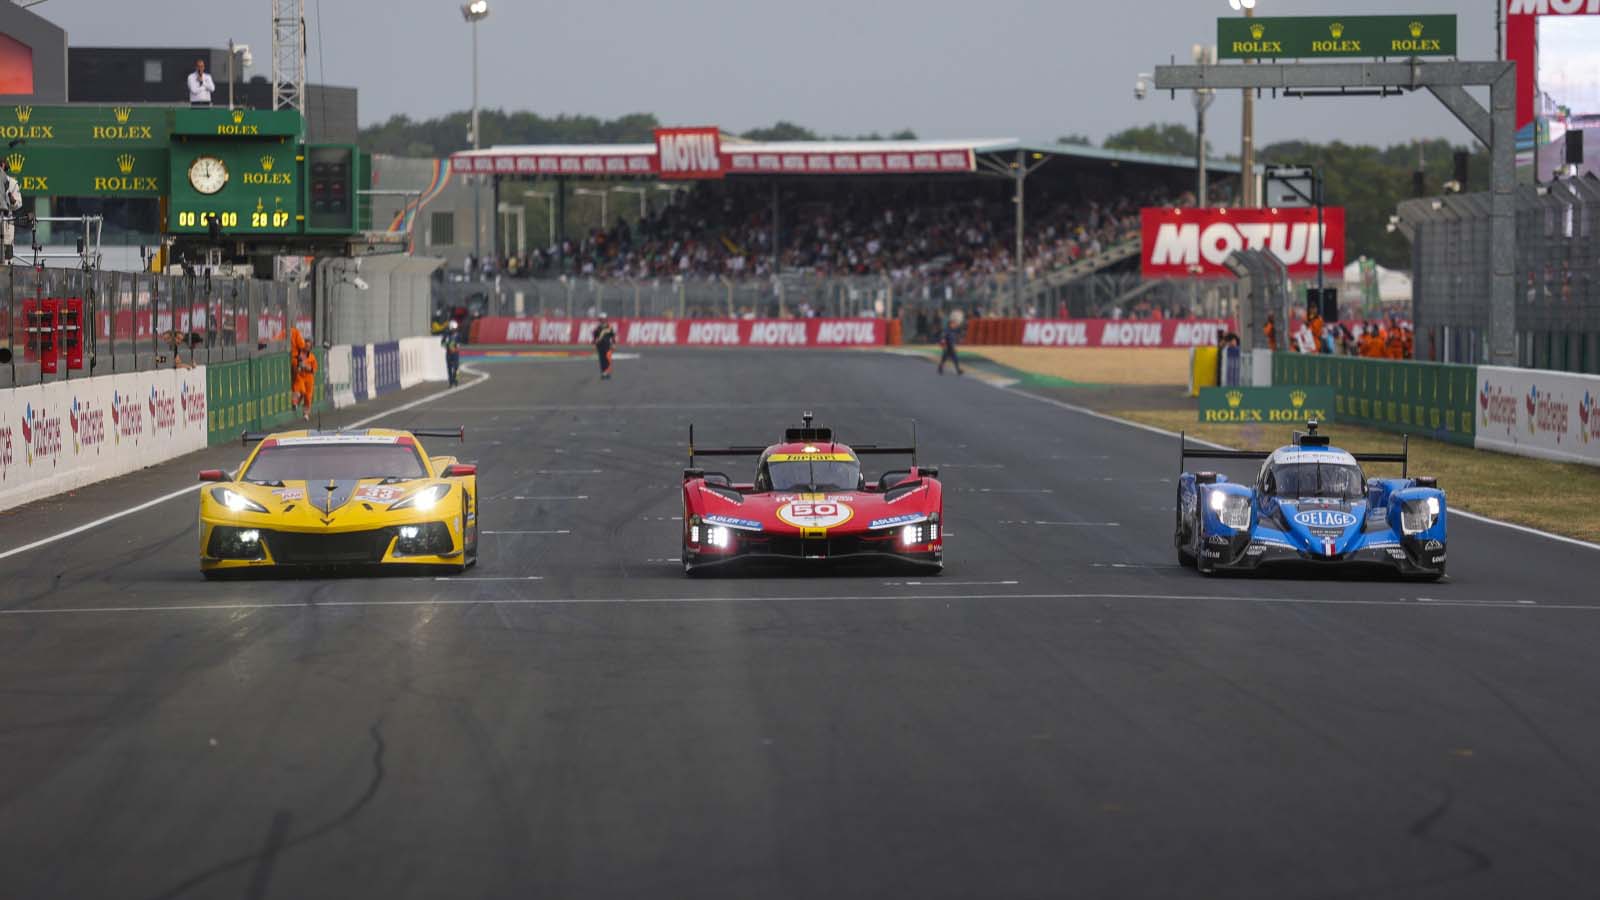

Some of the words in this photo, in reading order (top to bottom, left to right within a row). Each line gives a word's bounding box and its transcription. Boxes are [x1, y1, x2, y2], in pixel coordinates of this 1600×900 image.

[1232, 41, 1283, 53] ROLEX
[1312, 40, 1361, 52] ROLEX
[1391, 39, 1441, 50] ROLEX
[93, 126, 152, 139] ROLEX
[217, 125, 259, 135] ROLEX
[659, 133, 721, 172] MOTUL
[94, 177, 159, 191] ROLEX
[243, 172, 292, 184] ROLEX
[179, 212, 195, 227] 00
[221, 212, 237, 227] 00
[273, 212, 289, 228] 07
[1150, 222, 1335, 266] MOTUL
[627, 322, 677, 343] MOTUL
[687, 322, 740, 344] MOTUL
[749, 322, 808, 344] MOTUL
[816, 322, 876, 344] MOTUL
[1022, 323, 1088, 345] MOTUL
[1102, 323, 1163, 345] MOTUL
[1173, 323, 1229, 345] MOTU
[1205, 409, 1262, 421] ROLEX
[1269, 409, 1326, 421] ROLEX
[366, 486, 395, 499] 33
[794, 504, 836, 516] 50
[708, 515, 740, 524] ADLER
[1301, 511, 1350, 525] DELAGE
